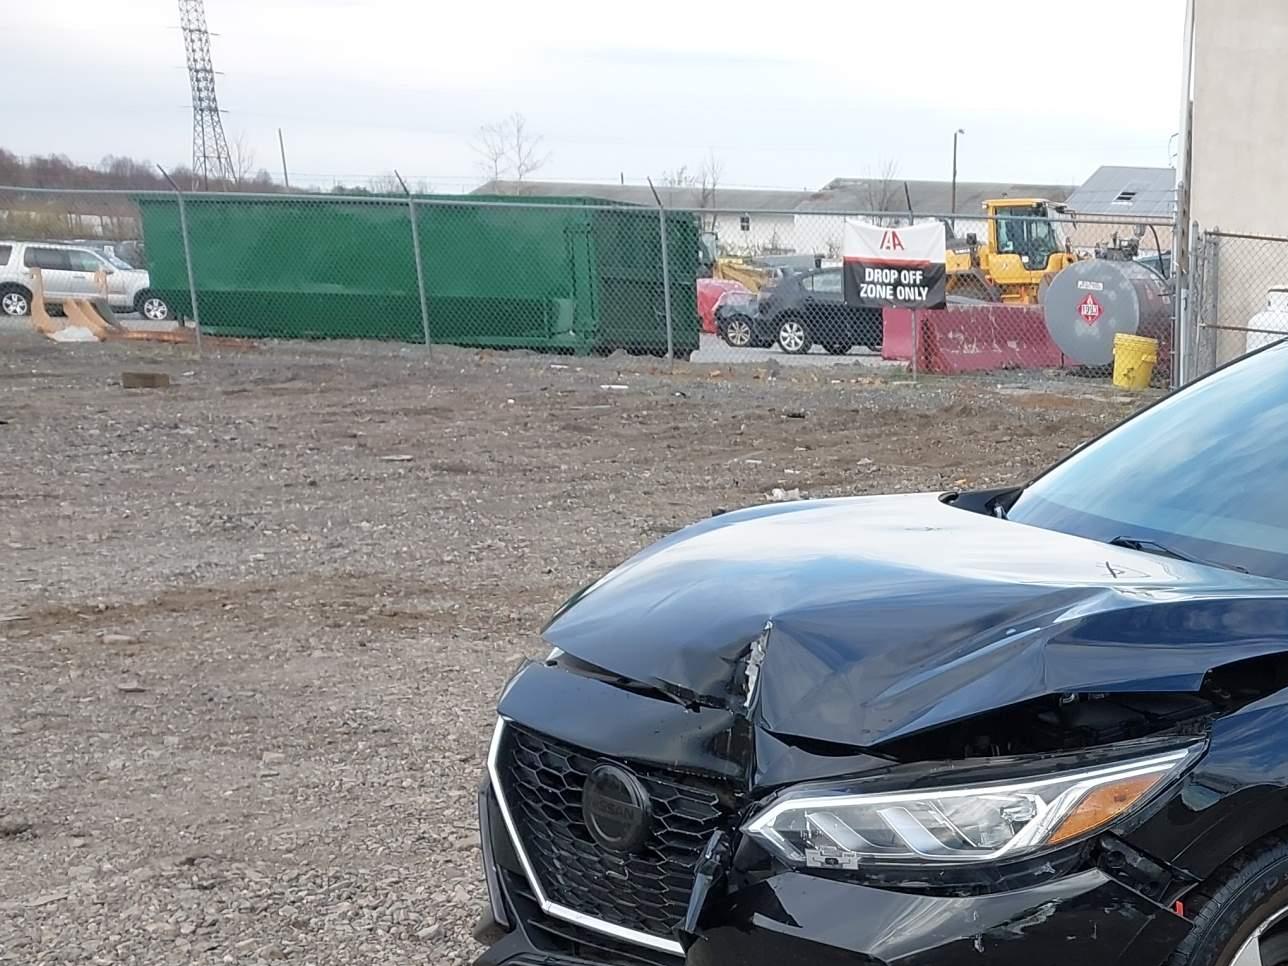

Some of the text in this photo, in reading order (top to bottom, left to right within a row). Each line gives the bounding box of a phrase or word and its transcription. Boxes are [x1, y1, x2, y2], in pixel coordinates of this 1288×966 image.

[865, 268, 924, 285] DROP OFF
[860, 283, 929, 301] ZONE ONLY
